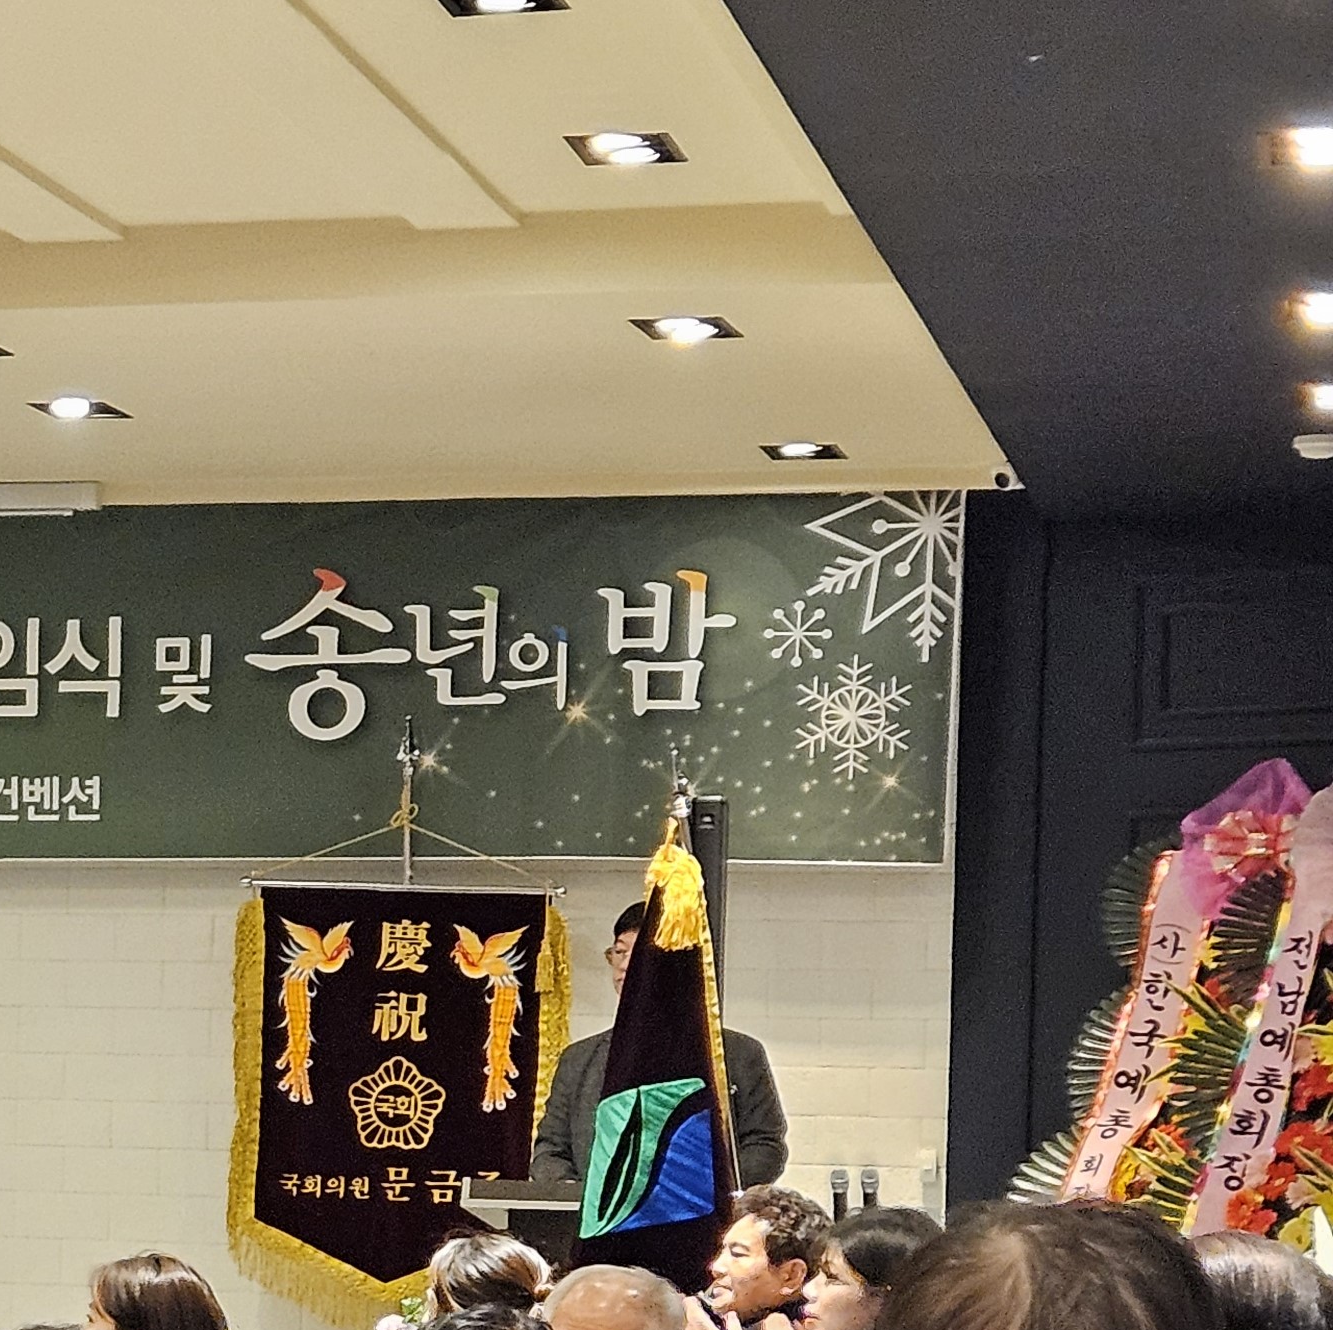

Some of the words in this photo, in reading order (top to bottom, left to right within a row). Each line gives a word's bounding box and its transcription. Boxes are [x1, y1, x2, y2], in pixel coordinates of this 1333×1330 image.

[154, 633, 213, 714] 및
[244, 567, 568, 742] 송년의
[596, 569, 738, 717] 밤
[371, 919, 432, 1042] 慶祝
[374, 1094, 416, 1119] 국회
[278, 1172, 370, 1200] 국회의원
